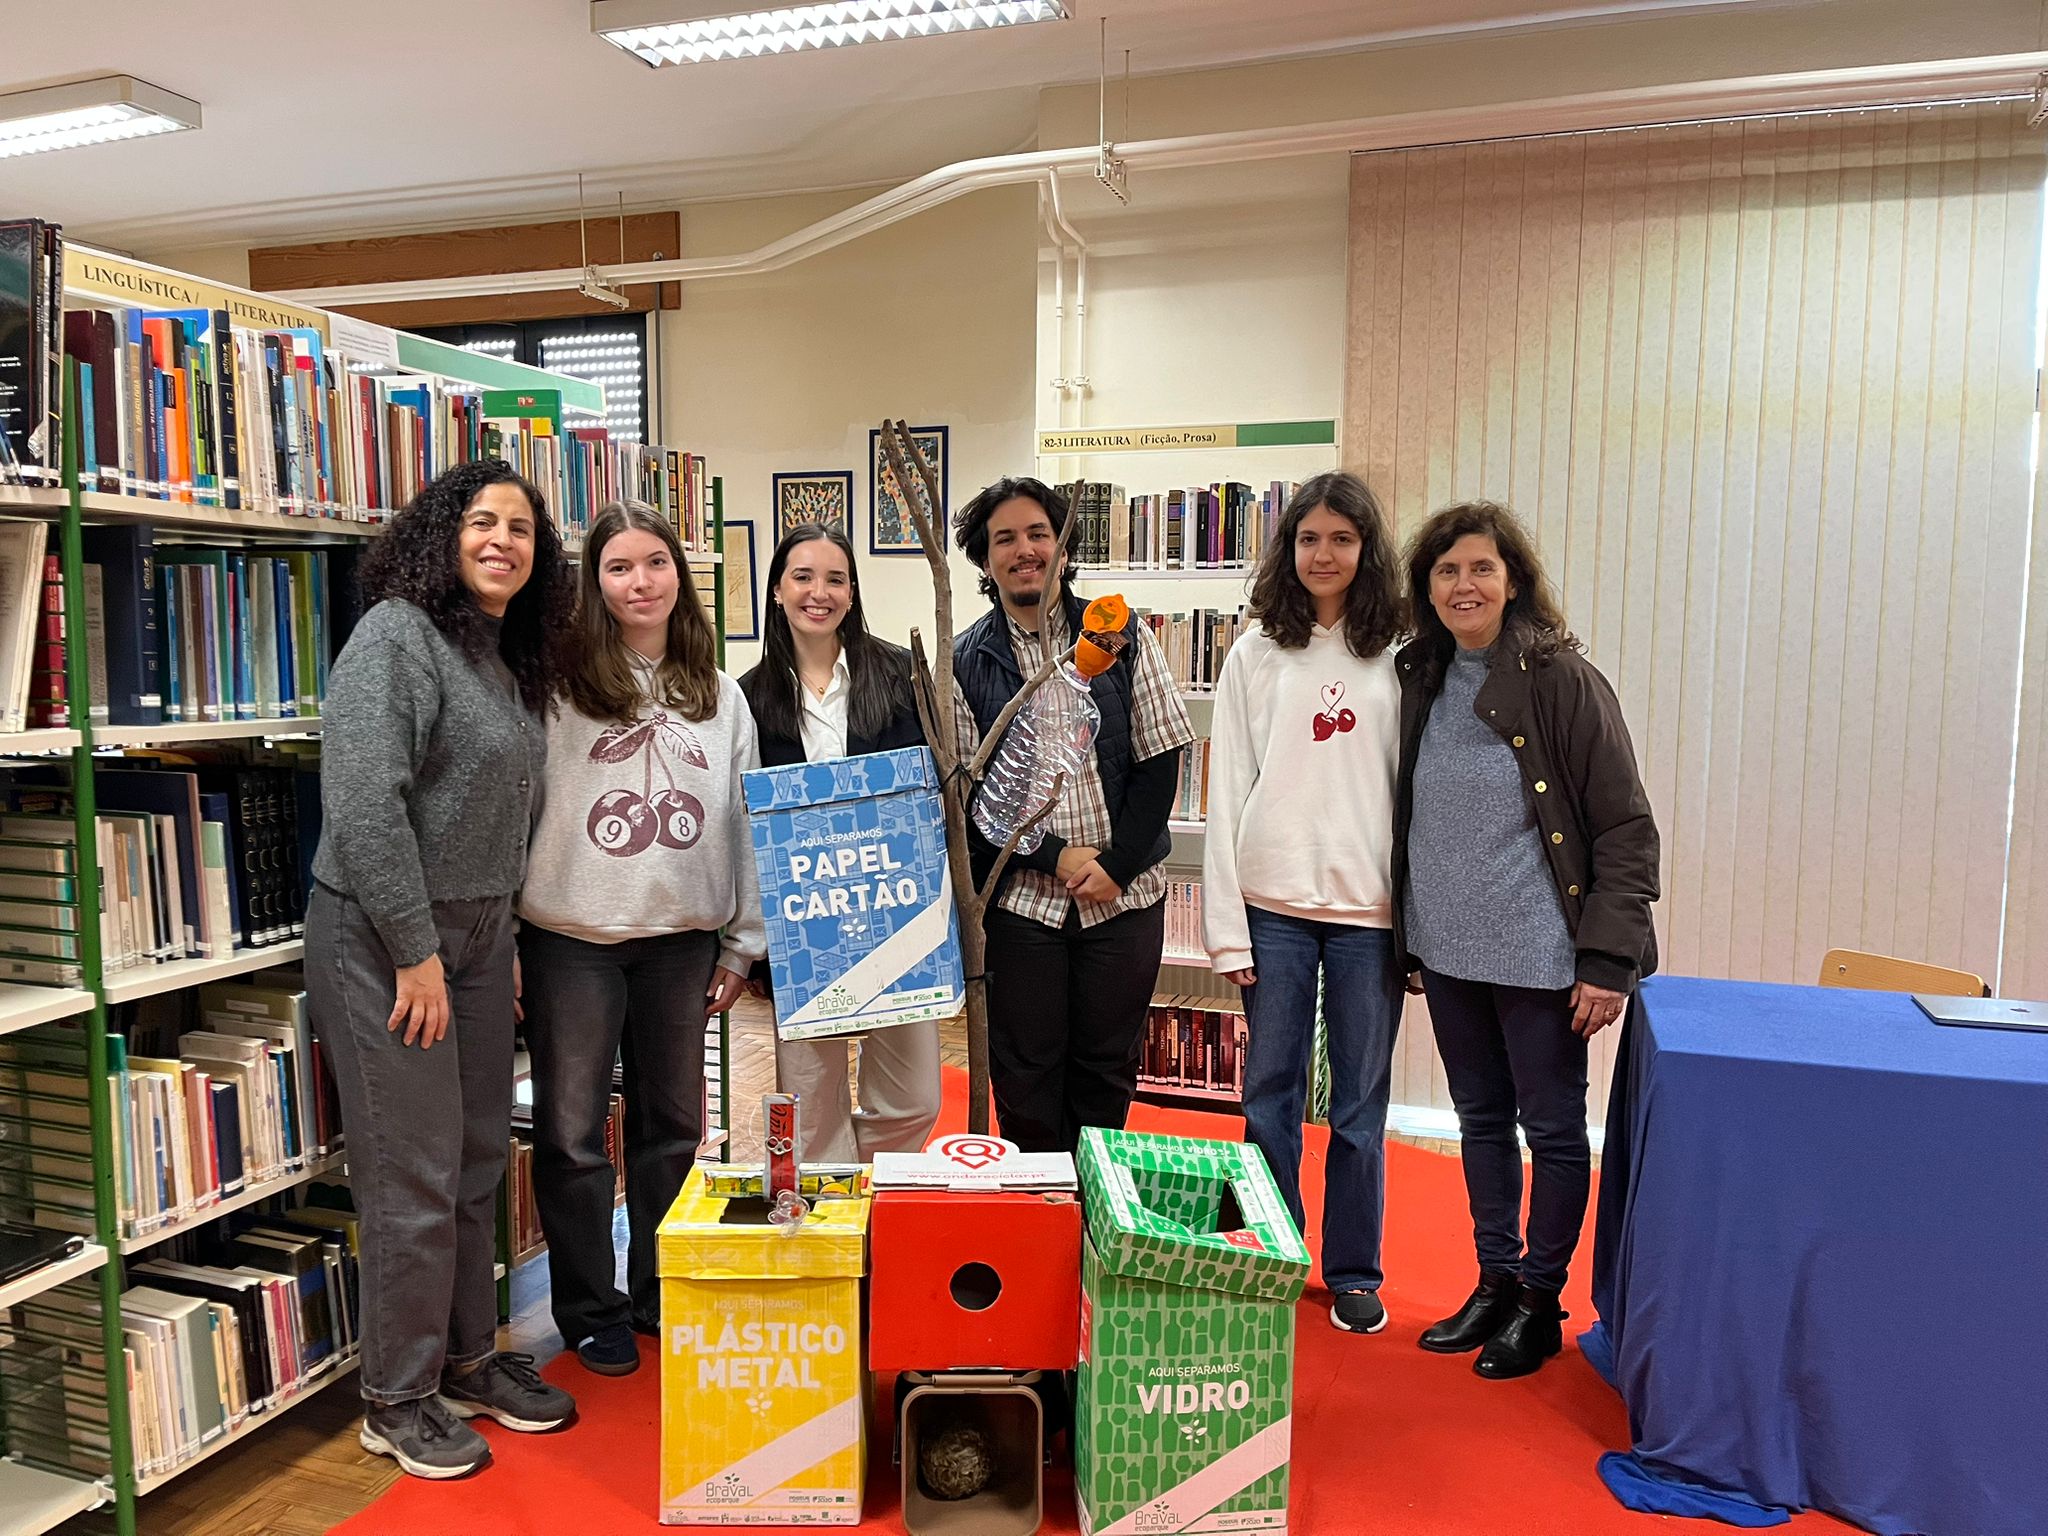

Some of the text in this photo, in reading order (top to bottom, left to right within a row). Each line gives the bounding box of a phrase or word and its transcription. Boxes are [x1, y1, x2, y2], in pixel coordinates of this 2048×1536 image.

[83, 264, 193, 304] LINGUÍSTICA
[1063, 436, 1131, 448] LITERATURA
[1183, 432, 1217, 444] Prosa)
[602, 816, 690, 843] 9 8
[800, 827, 883, 848] AQUI SEPARAMOS
[790, 842, 902, 883] PAPEL
[783, 874, 918, 922] CARTÃO
[1115, 1138, 1216, 1156] AQUI SEPARAMOS VIDRO
[741, 1299, 805, 1311] SEPARAMOS
[672, 1313, 846, 1355] PLÁSTICO
[698, 1357, 821, 1390] METAL
[1148, 1363, 1240, 1378] AQUI SEPARAMOS
[1136, 1379, 1250, 1415] VIDRO
